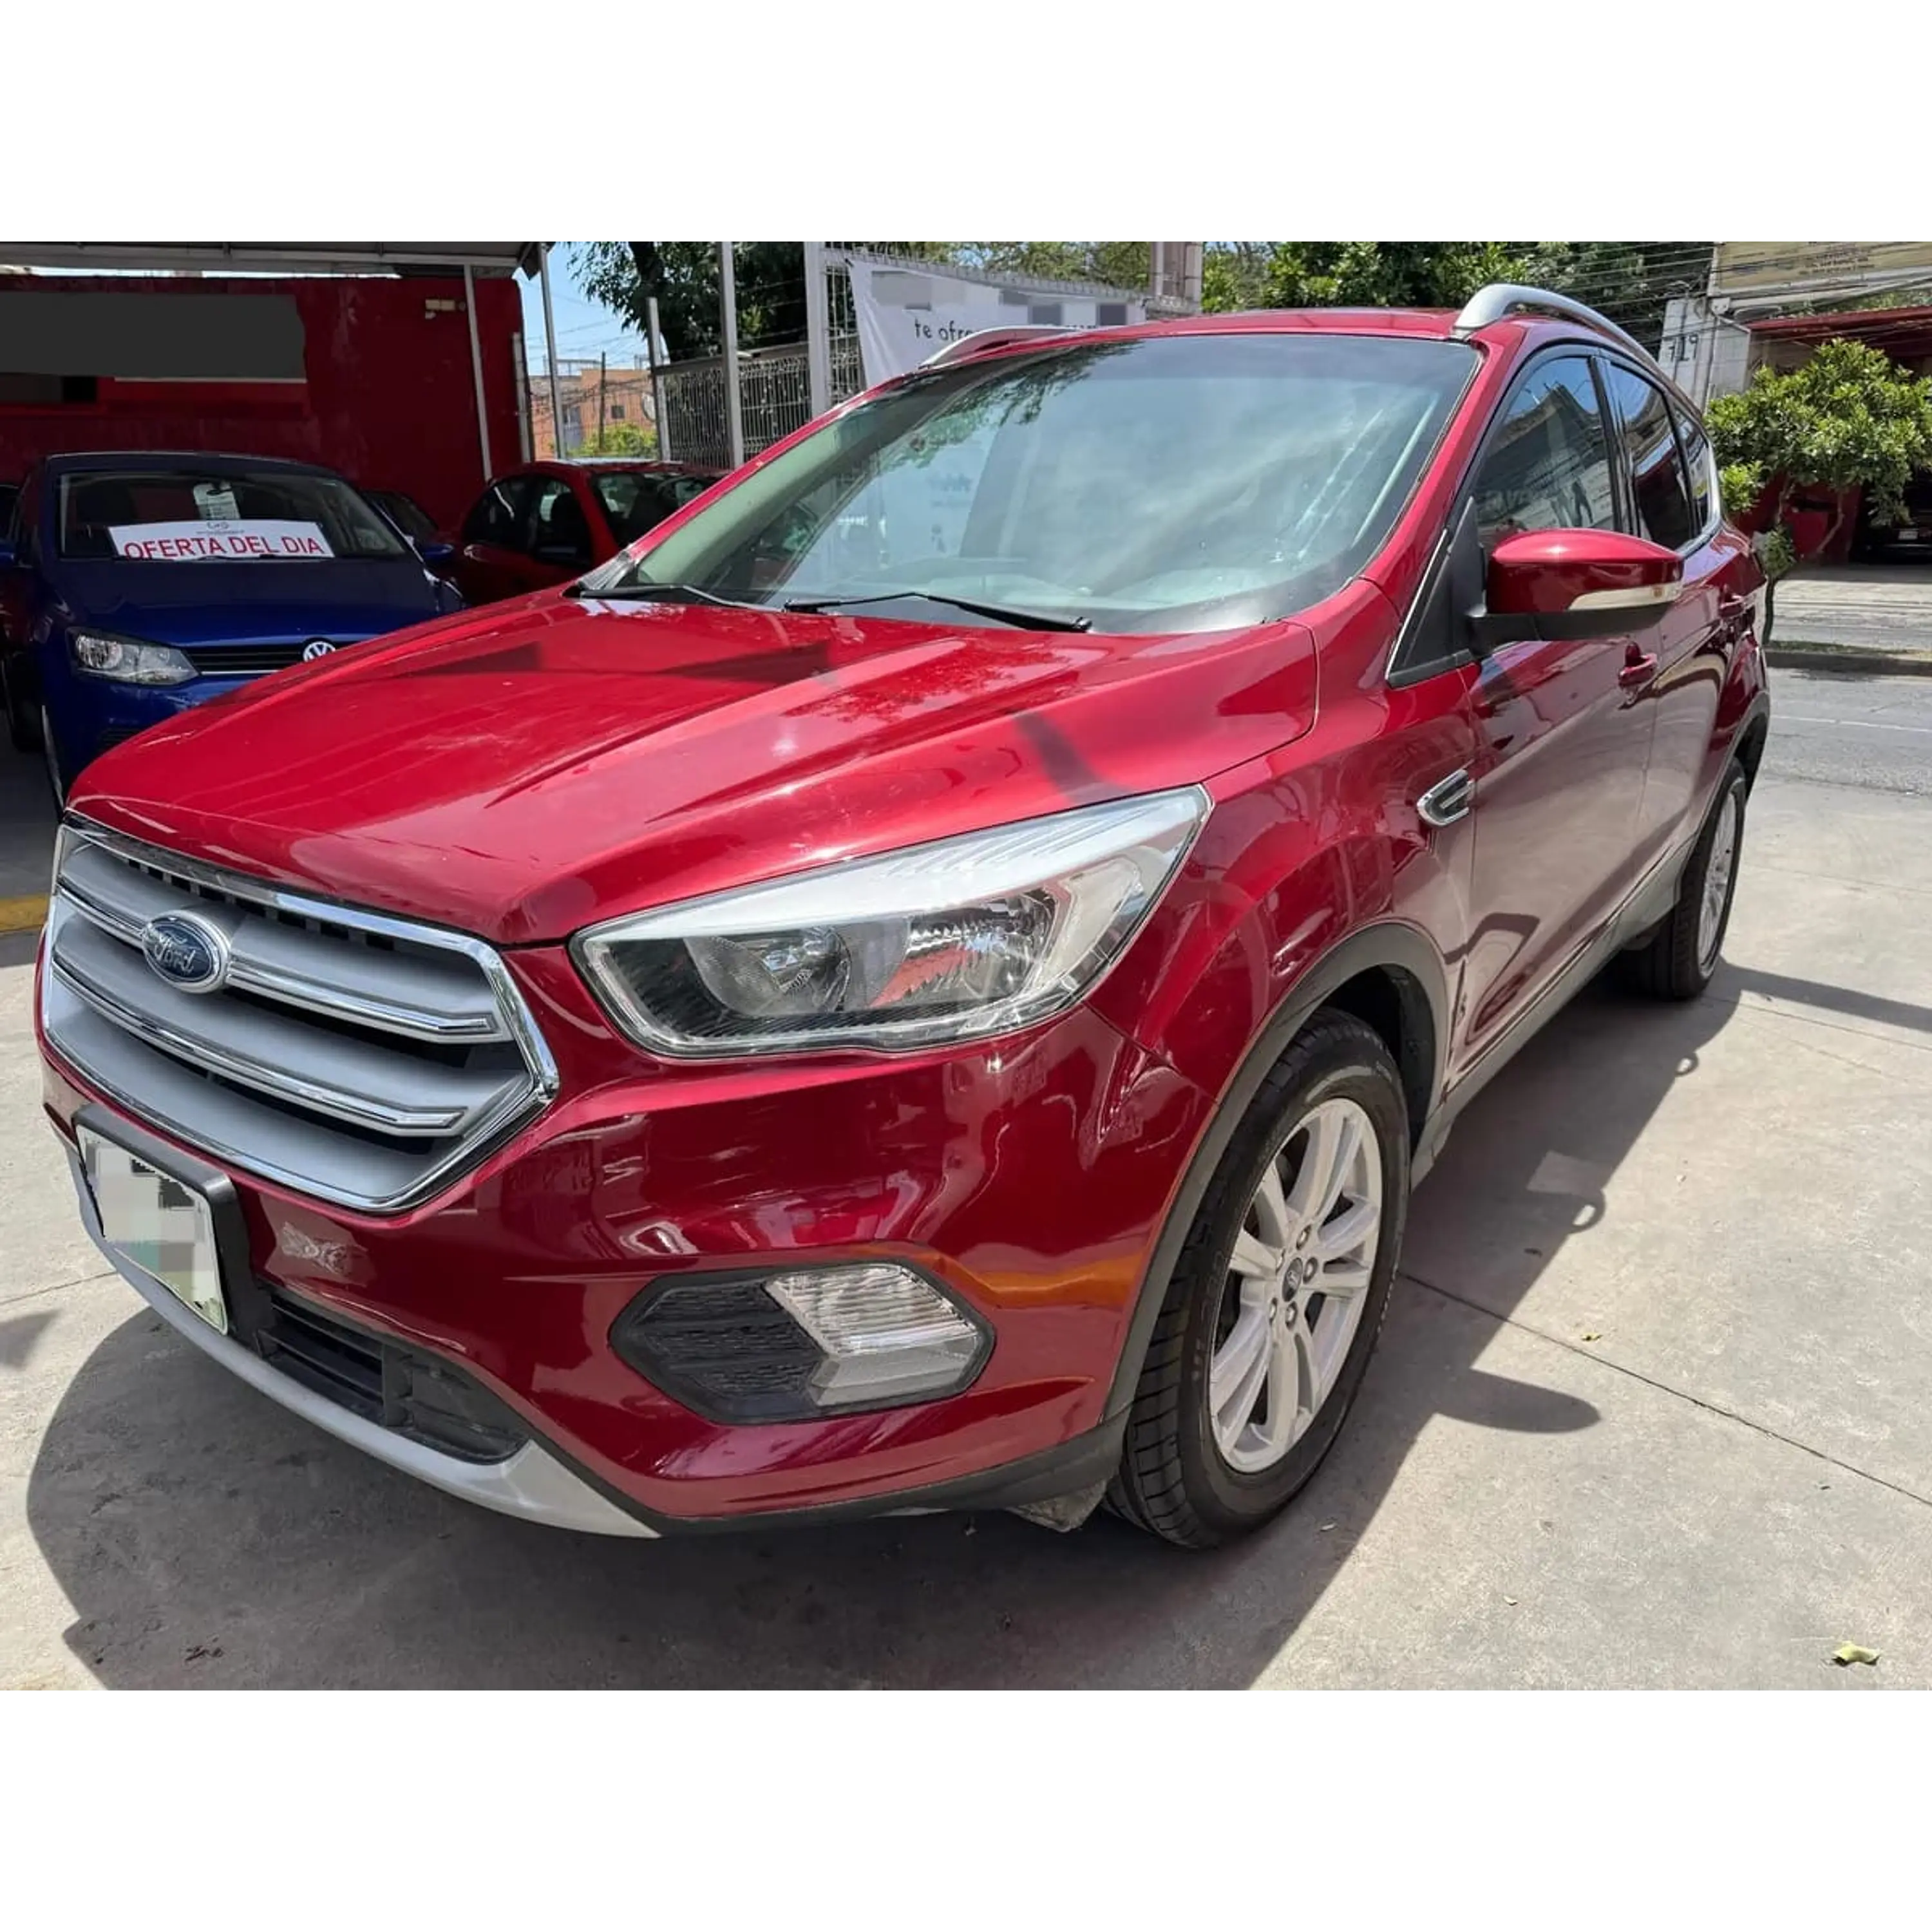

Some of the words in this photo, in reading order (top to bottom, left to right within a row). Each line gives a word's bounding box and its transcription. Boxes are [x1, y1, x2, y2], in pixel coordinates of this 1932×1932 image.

[914, 318, 933, 338] te
[124, 536, 227, 560] OFERTA
[227, 536, 279, 554] DEL
[281, 536, 325, 554] DIA
